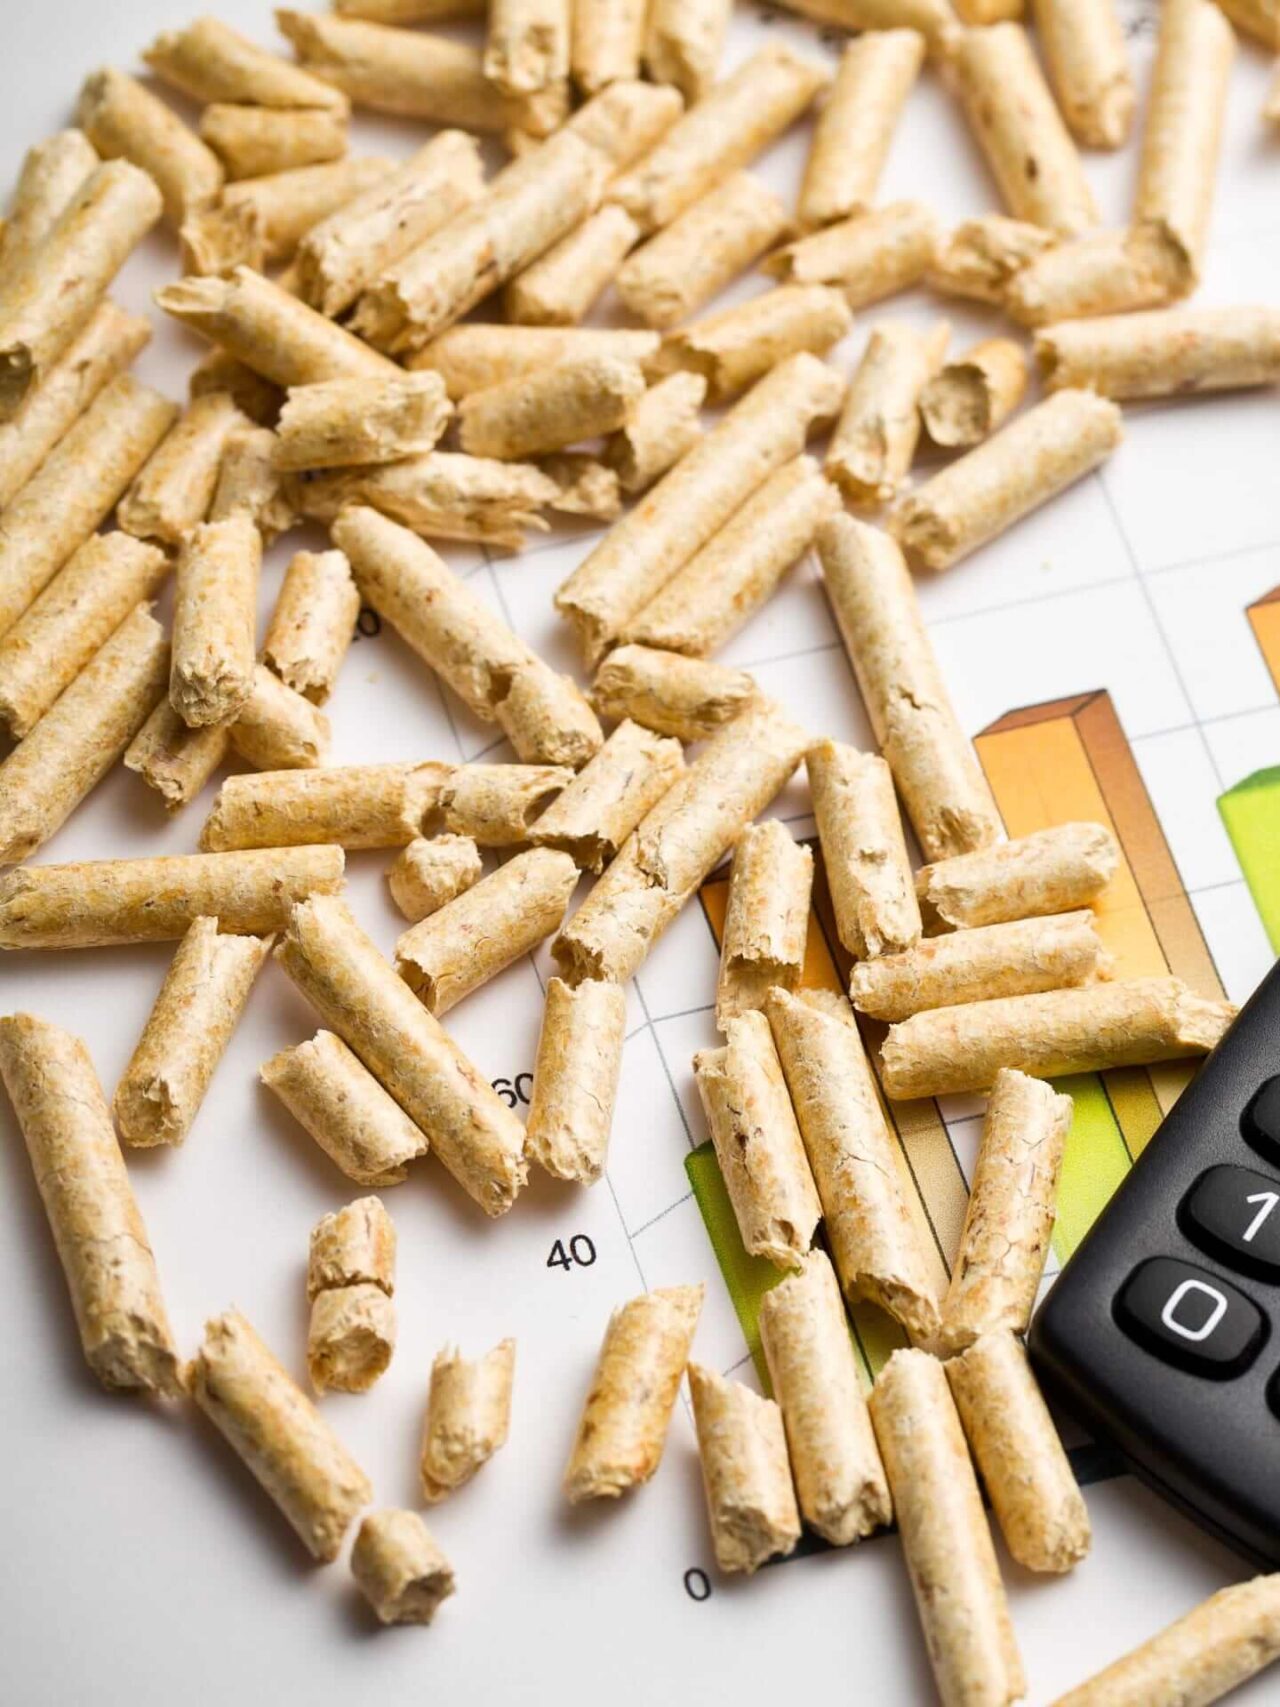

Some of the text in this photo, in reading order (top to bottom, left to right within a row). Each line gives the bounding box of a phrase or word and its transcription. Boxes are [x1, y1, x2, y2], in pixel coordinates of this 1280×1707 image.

[1242, 1191, 1280, 1242] 1
[546, 1234, 597, 1272] 40
[1161, 1279, 1228, 1341] 0
[684, 1568, 712, 1602] 0
